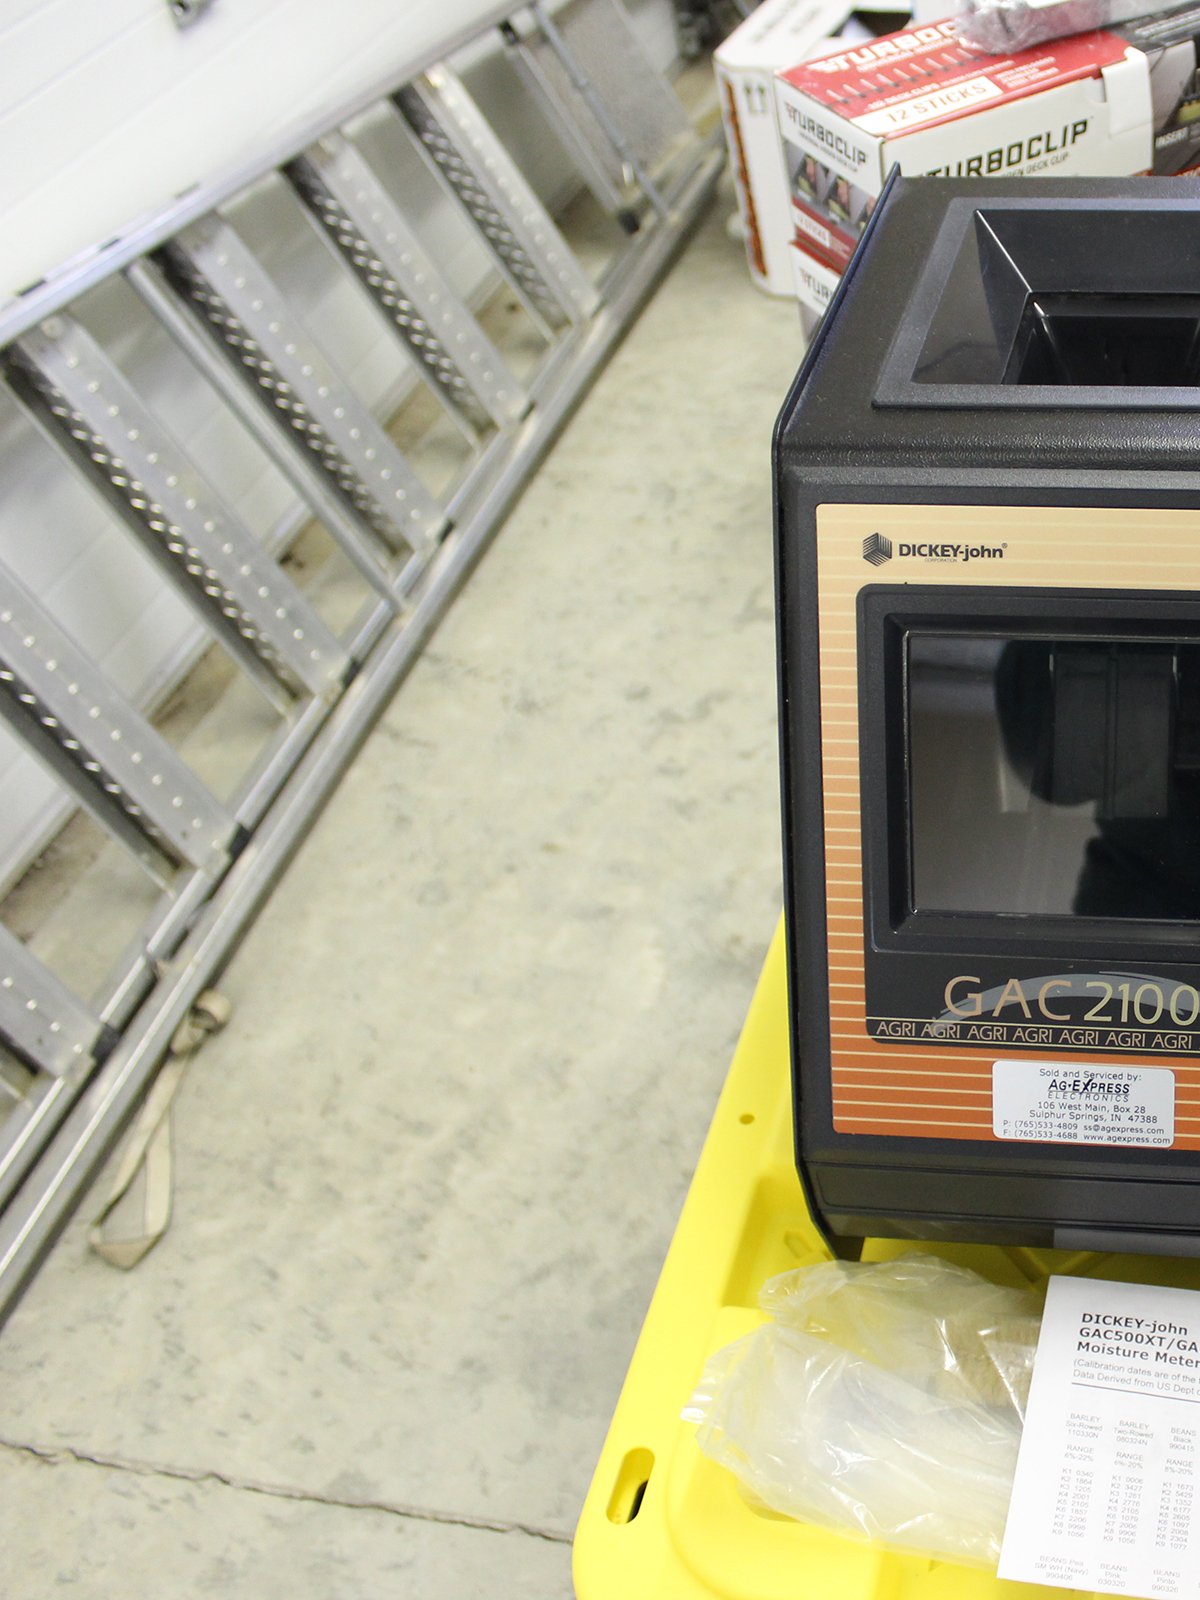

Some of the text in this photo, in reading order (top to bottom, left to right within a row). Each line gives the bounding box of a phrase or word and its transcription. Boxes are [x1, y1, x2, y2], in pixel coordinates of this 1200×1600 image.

[887, 109, 907, 123] 12
[913, 82, 987, 113] STICKS
[944, 975, 1200, 1027] GAC 2100
[876, 1021, 916, 1036] AGRI
[920, 1023, 960, 1039] AGRI
[967, 1025, 1007, 1041] AGRI
[1012, 1027, 1052, 1043] AGRI
[1058, 1029, 1099, 1045] AGRI
[1104, 1031, 1146, 1047] AGRI
[1151, 1033, 1192, 1049] AGRI
[1039, 1068, 1142, 1082] Sold and Serviced by:
[1047, 1092, 1129, 1103] ELECTRONICS
[1038, 1101, 1146, 1114] 106 West Main, Box 28
[1029, 1109, 1158, 1124] Sulphur Springs, IN 47388
[1014, 1120, 1078, 1131] (765)533-4809
[1083, 1124, 1165, 1135] ss@agexpress.com
[1014, 1129, 1078, 1140] (765)533-4688
[1083, 1133, 1170, 1145] www.agexpress.com
[1081, 1312, 1188, 1336] DICKEY-john
[1077, 1341, 1149, 1360] Moisture
[1073, 1358, 1125, 1372] (Calibration
[1127, 1366, 1151, 1377] dates
[1154, 1371, 1169, 1380] are
[1171, 1372, 1181, 1380] of
[1182, 1374, 1196, 1384] the
[1073, 1369, 1095, 1380] Data
[1097, 1372, 1132, 1385] Derived
[1134, 1377, 1154, 1388] from
[1157, 1382, 1171, 1391] US
[1173, 1384, 1195, 1396] Dept
[1070, 1413, 1100, 1422] BARLEY
[1119, 1420, 1149, 1430] BARLEY
[1171, 1427, 1197, 1436] BEANS
[1067, 1445, 1094, 1454] RANGE
[1116, 1451, 1143, 1461] RANGE
[1166, 1458, 1193, 1468] RANGE
